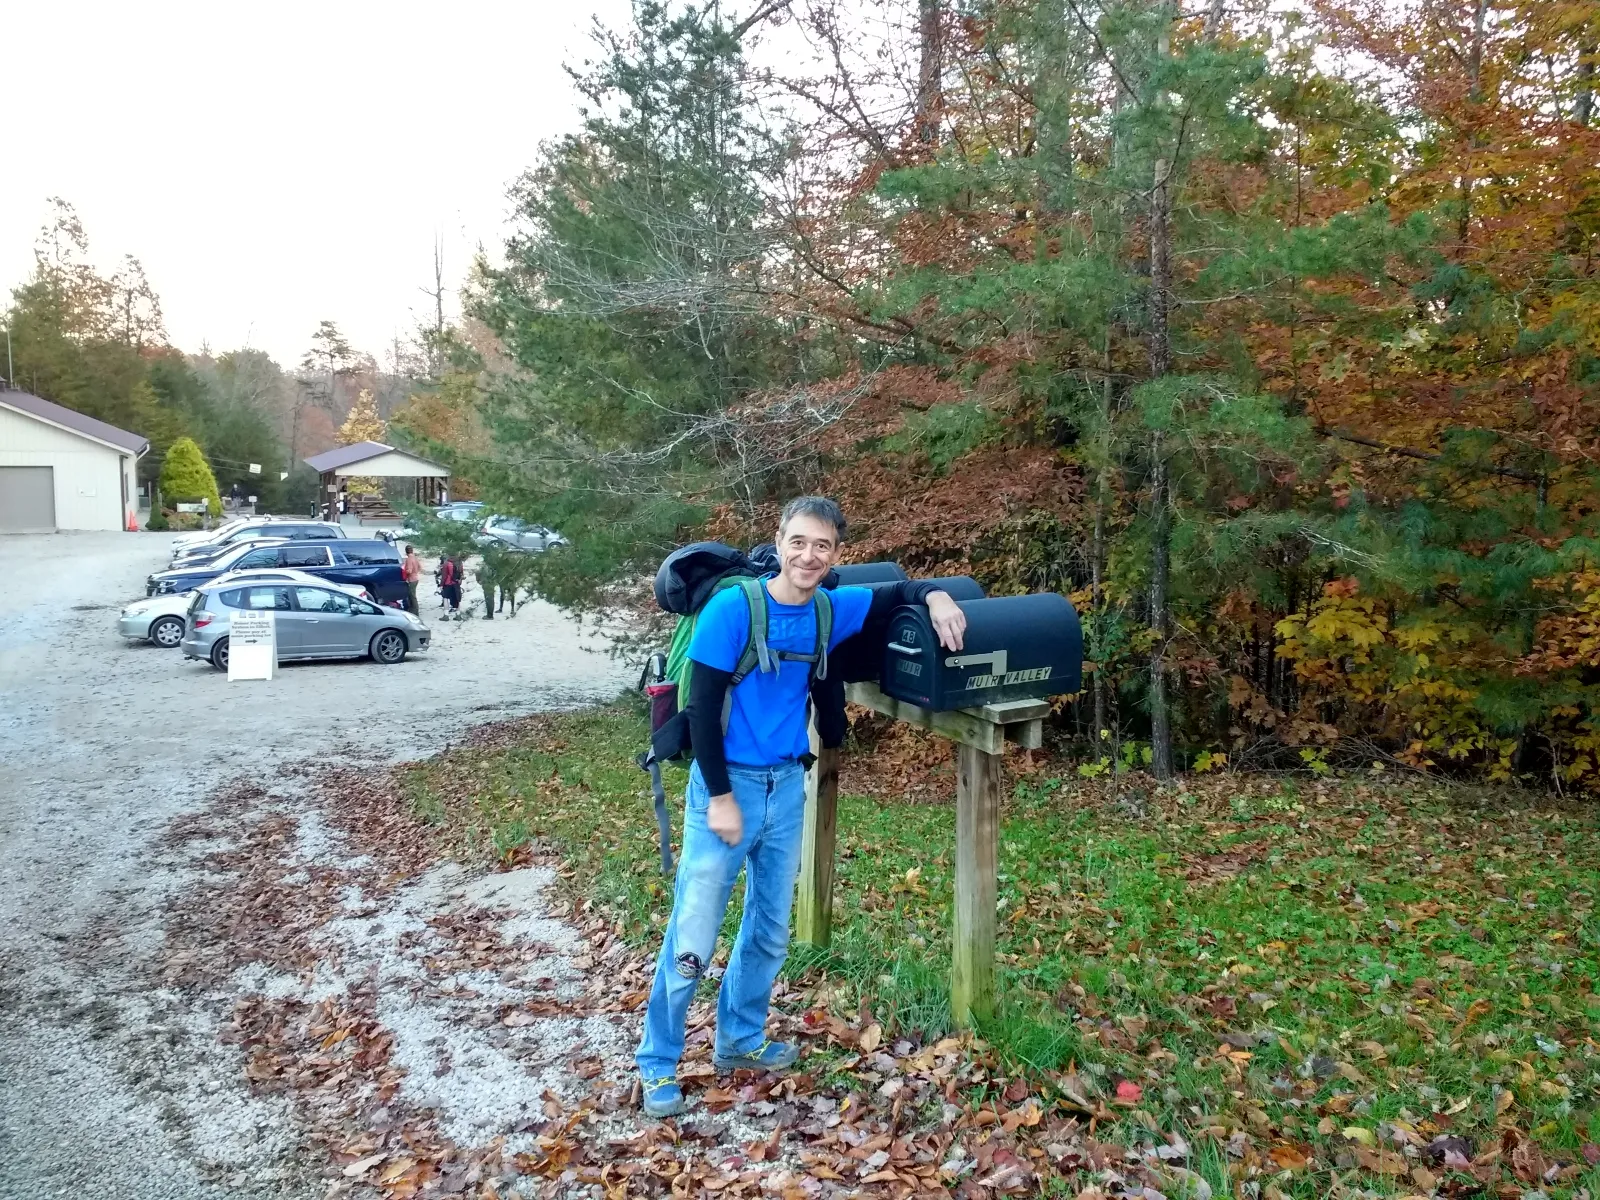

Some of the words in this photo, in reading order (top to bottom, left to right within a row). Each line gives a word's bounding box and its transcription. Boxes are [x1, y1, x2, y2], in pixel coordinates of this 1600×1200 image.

[902, 630, 915, 643] 48
[966, 674, 1000, 689] MUIR
[1005, 667, 1052, 684] VALLEY
